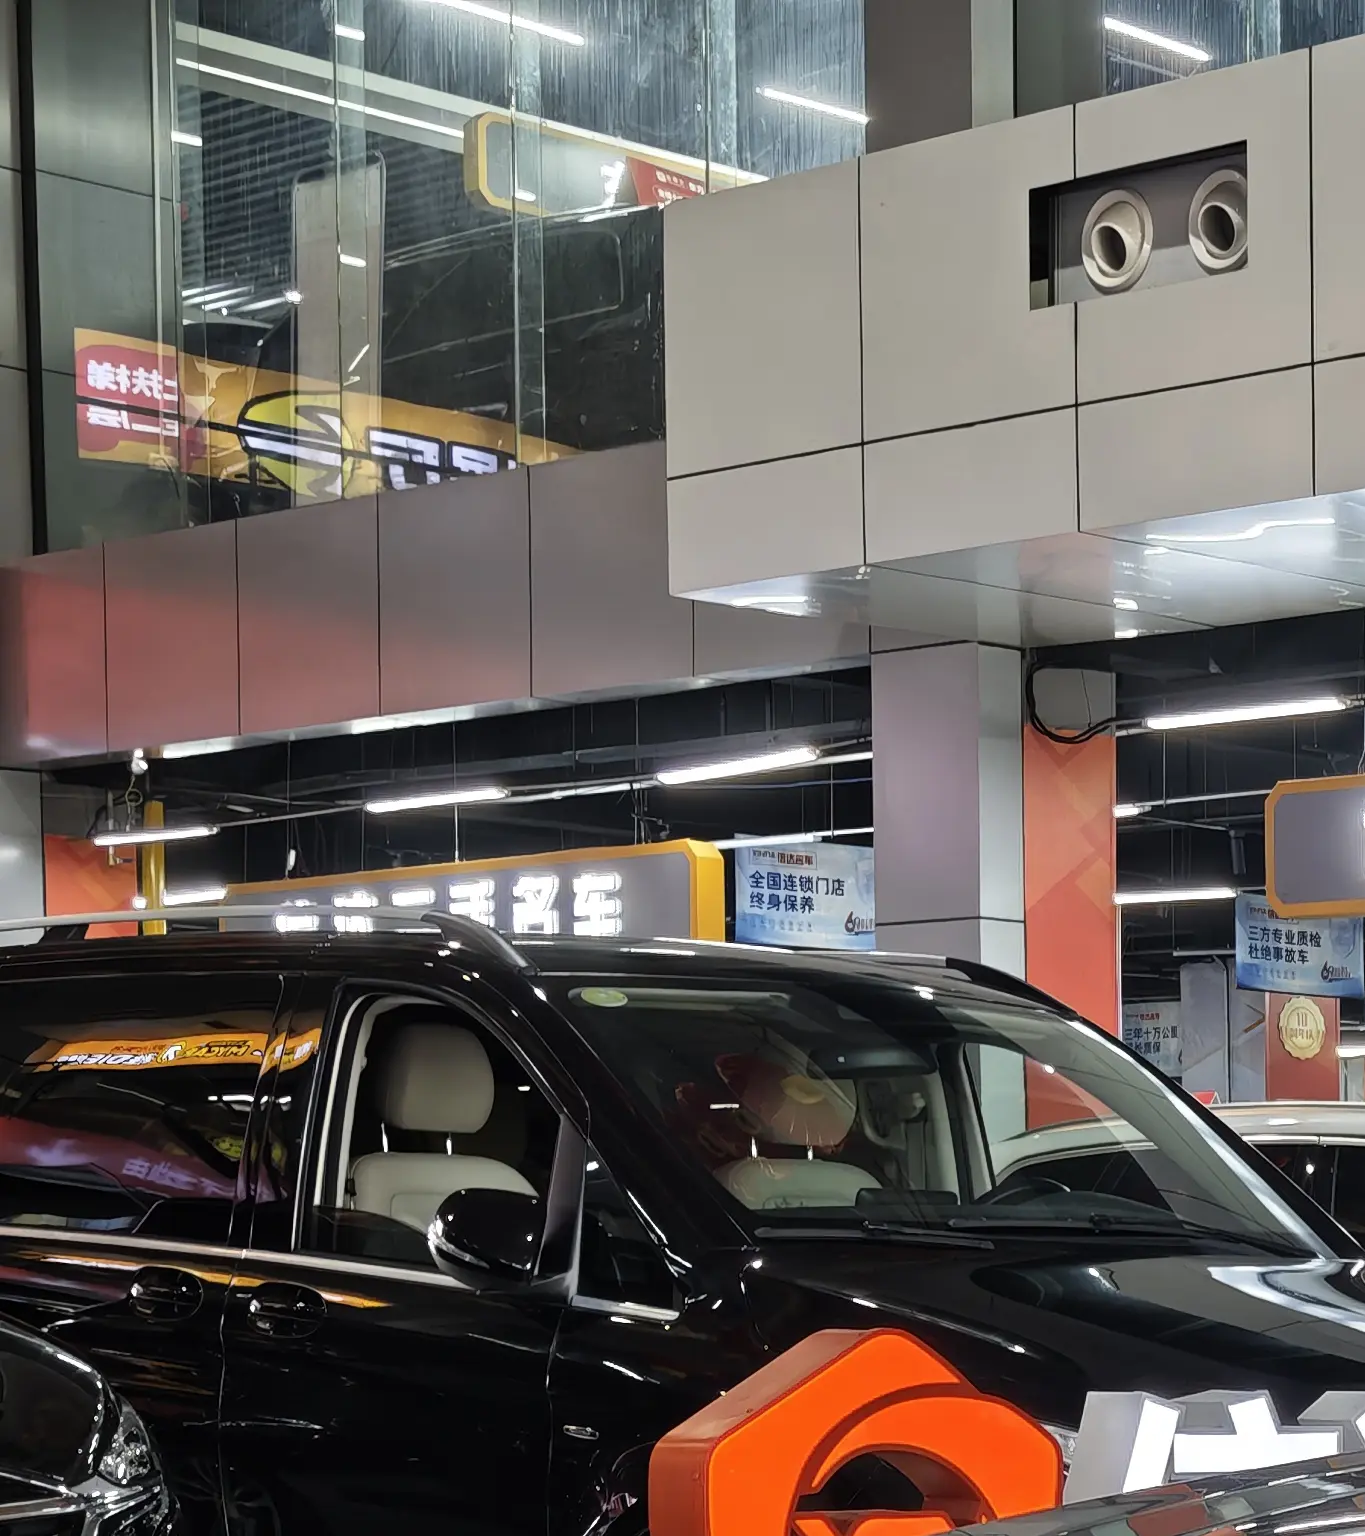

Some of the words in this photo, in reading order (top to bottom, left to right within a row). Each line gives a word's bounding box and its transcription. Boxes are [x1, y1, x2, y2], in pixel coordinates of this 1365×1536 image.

[748, 869, 846, 897] 全国连锁门店
[748, 891, 815, 914] 终身保养
[1247, 924, 1322, 948] 三方专业质检
[1247, 943, 1309, 965] 杜绝事故车
